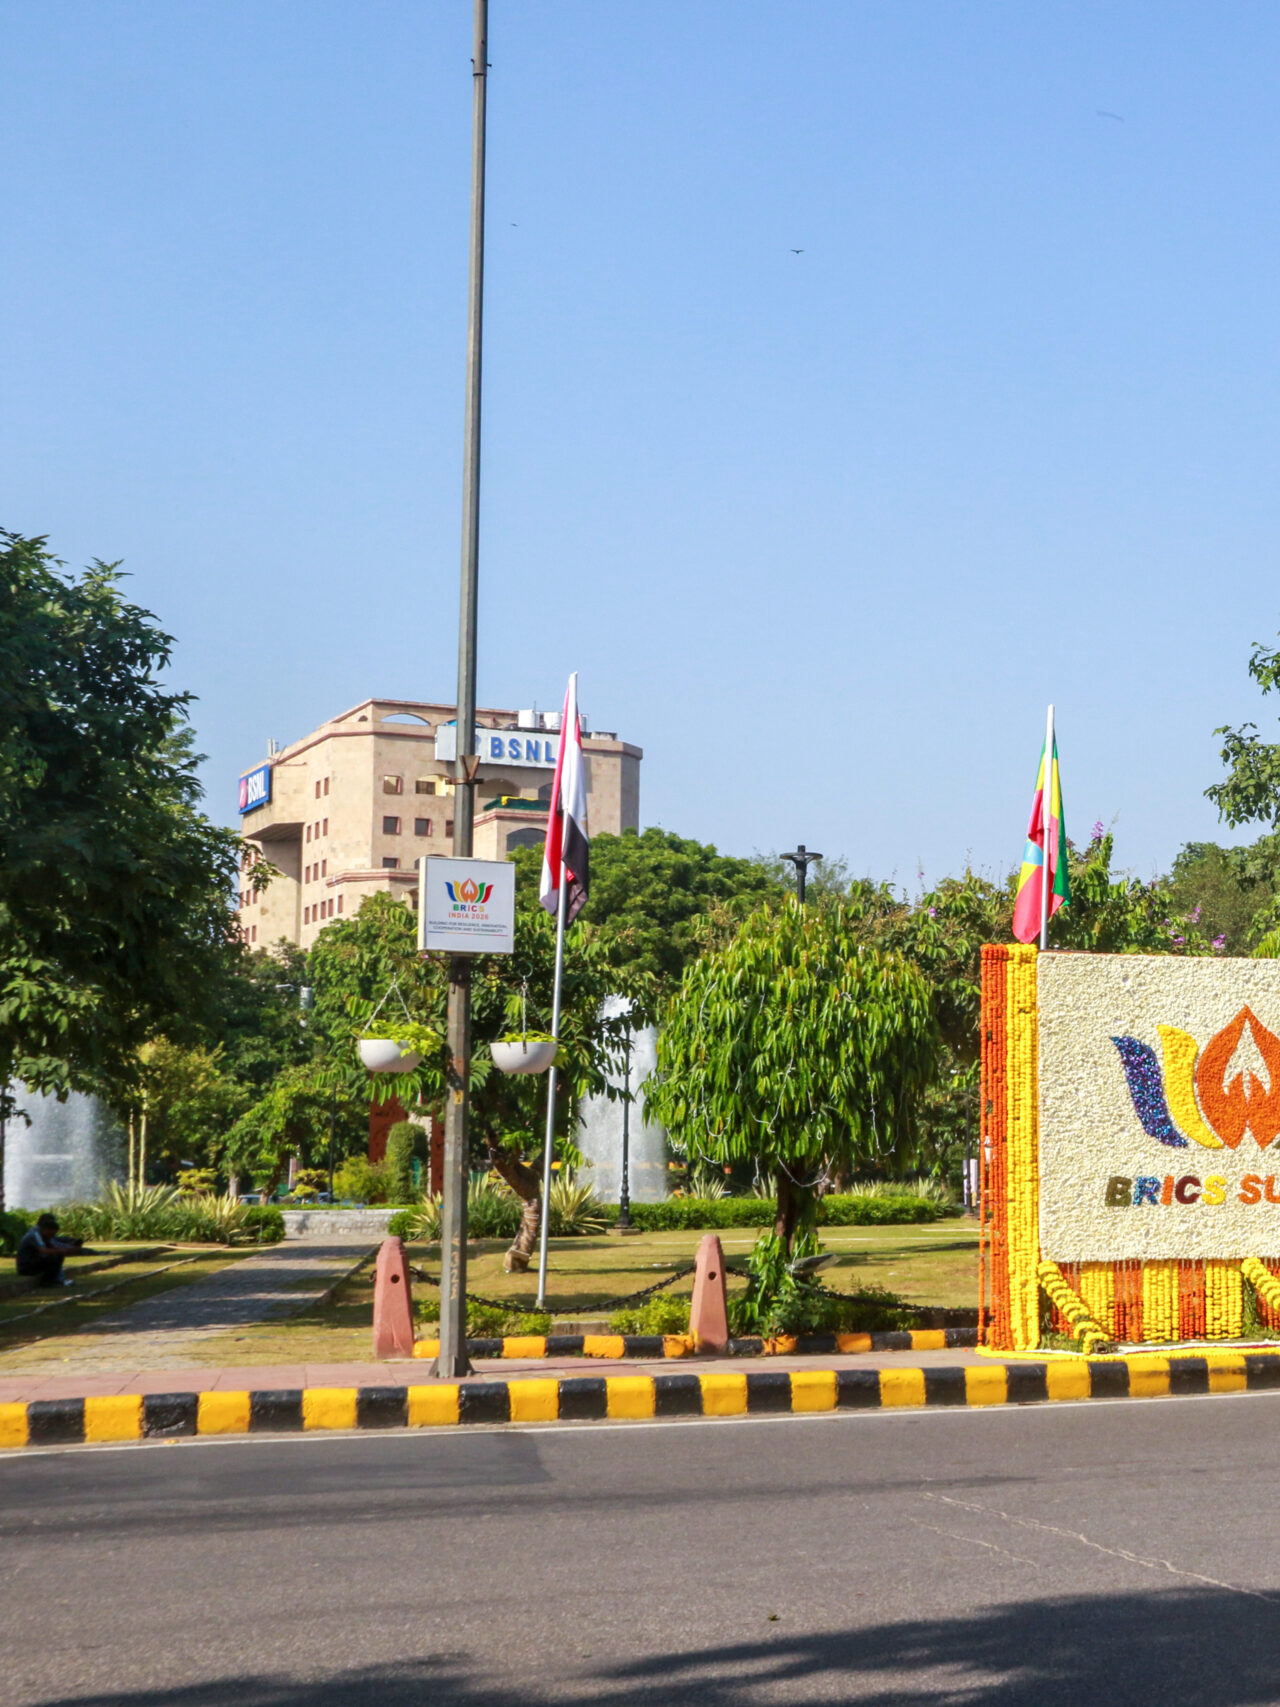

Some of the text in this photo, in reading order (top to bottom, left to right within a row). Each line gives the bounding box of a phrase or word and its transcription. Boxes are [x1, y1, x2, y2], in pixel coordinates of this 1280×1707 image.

[490, 736, 557, 763] BSNL
[248, 770, 266, 804] BSNL
[453, 904, 485, 912] BRICS
[1105, 1174, 1227, 1207] BRICS
